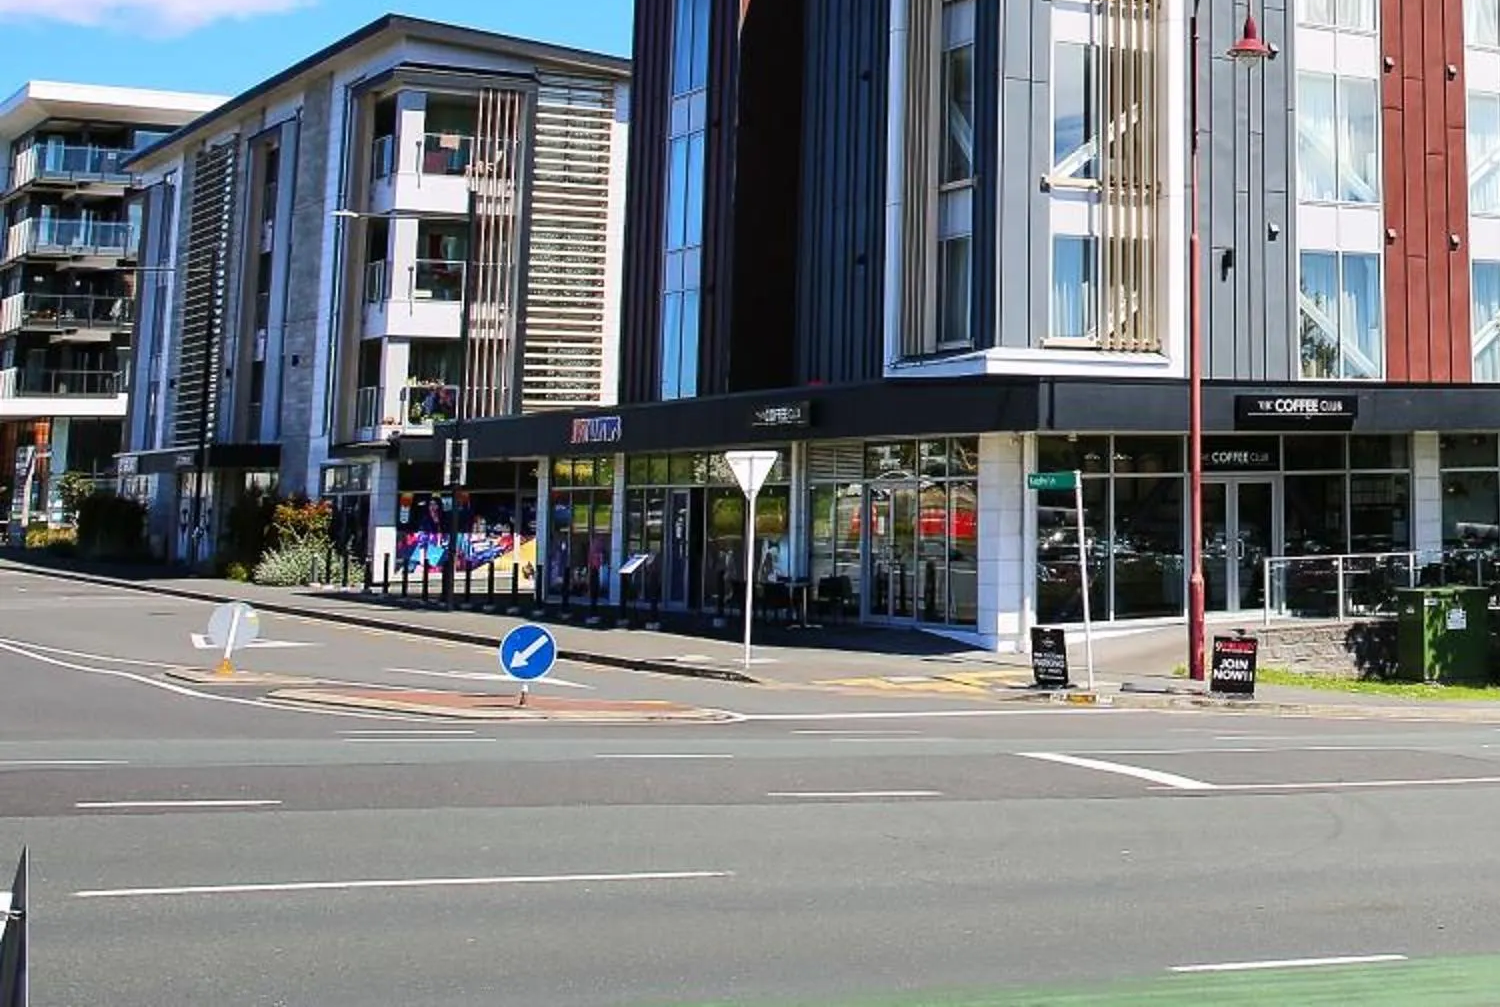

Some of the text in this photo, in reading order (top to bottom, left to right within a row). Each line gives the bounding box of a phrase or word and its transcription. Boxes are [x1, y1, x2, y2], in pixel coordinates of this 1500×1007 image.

[1275, 398, 1319, 412] COFFEE
[1320, 400, 1343, 411] CLUB
[1211, 451, 1249, 464] COFFEE
[1219, 658, 1249, 670] JOIN
